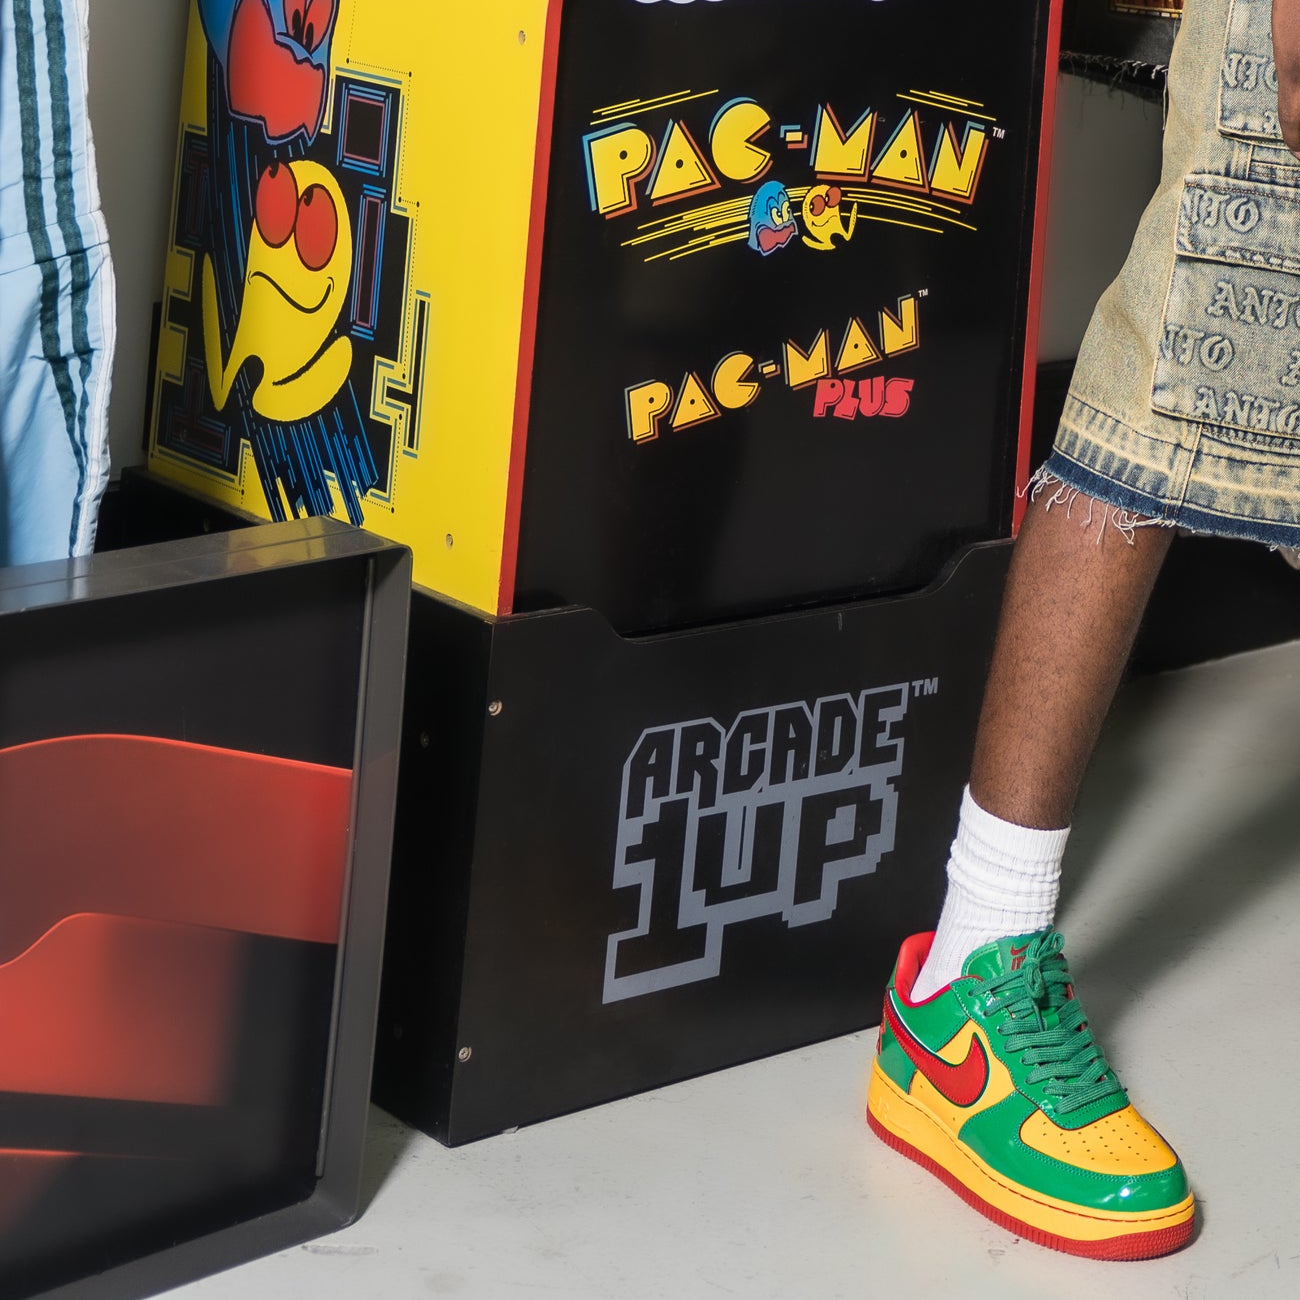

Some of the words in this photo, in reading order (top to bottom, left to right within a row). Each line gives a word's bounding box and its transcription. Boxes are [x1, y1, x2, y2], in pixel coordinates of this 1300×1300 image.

[582, 97, 989, 220] PAC-MAN
[1185, 188, 1260, 233] NTO
[624, 296, 920, 445] PAC-MAN
[813, 376, 914, 420] PLUS
[1161, 323, 1235, 372] NTO
[622, 681, 910, 820] ARCADE
[602, 772, 899, 1004] 1UP
